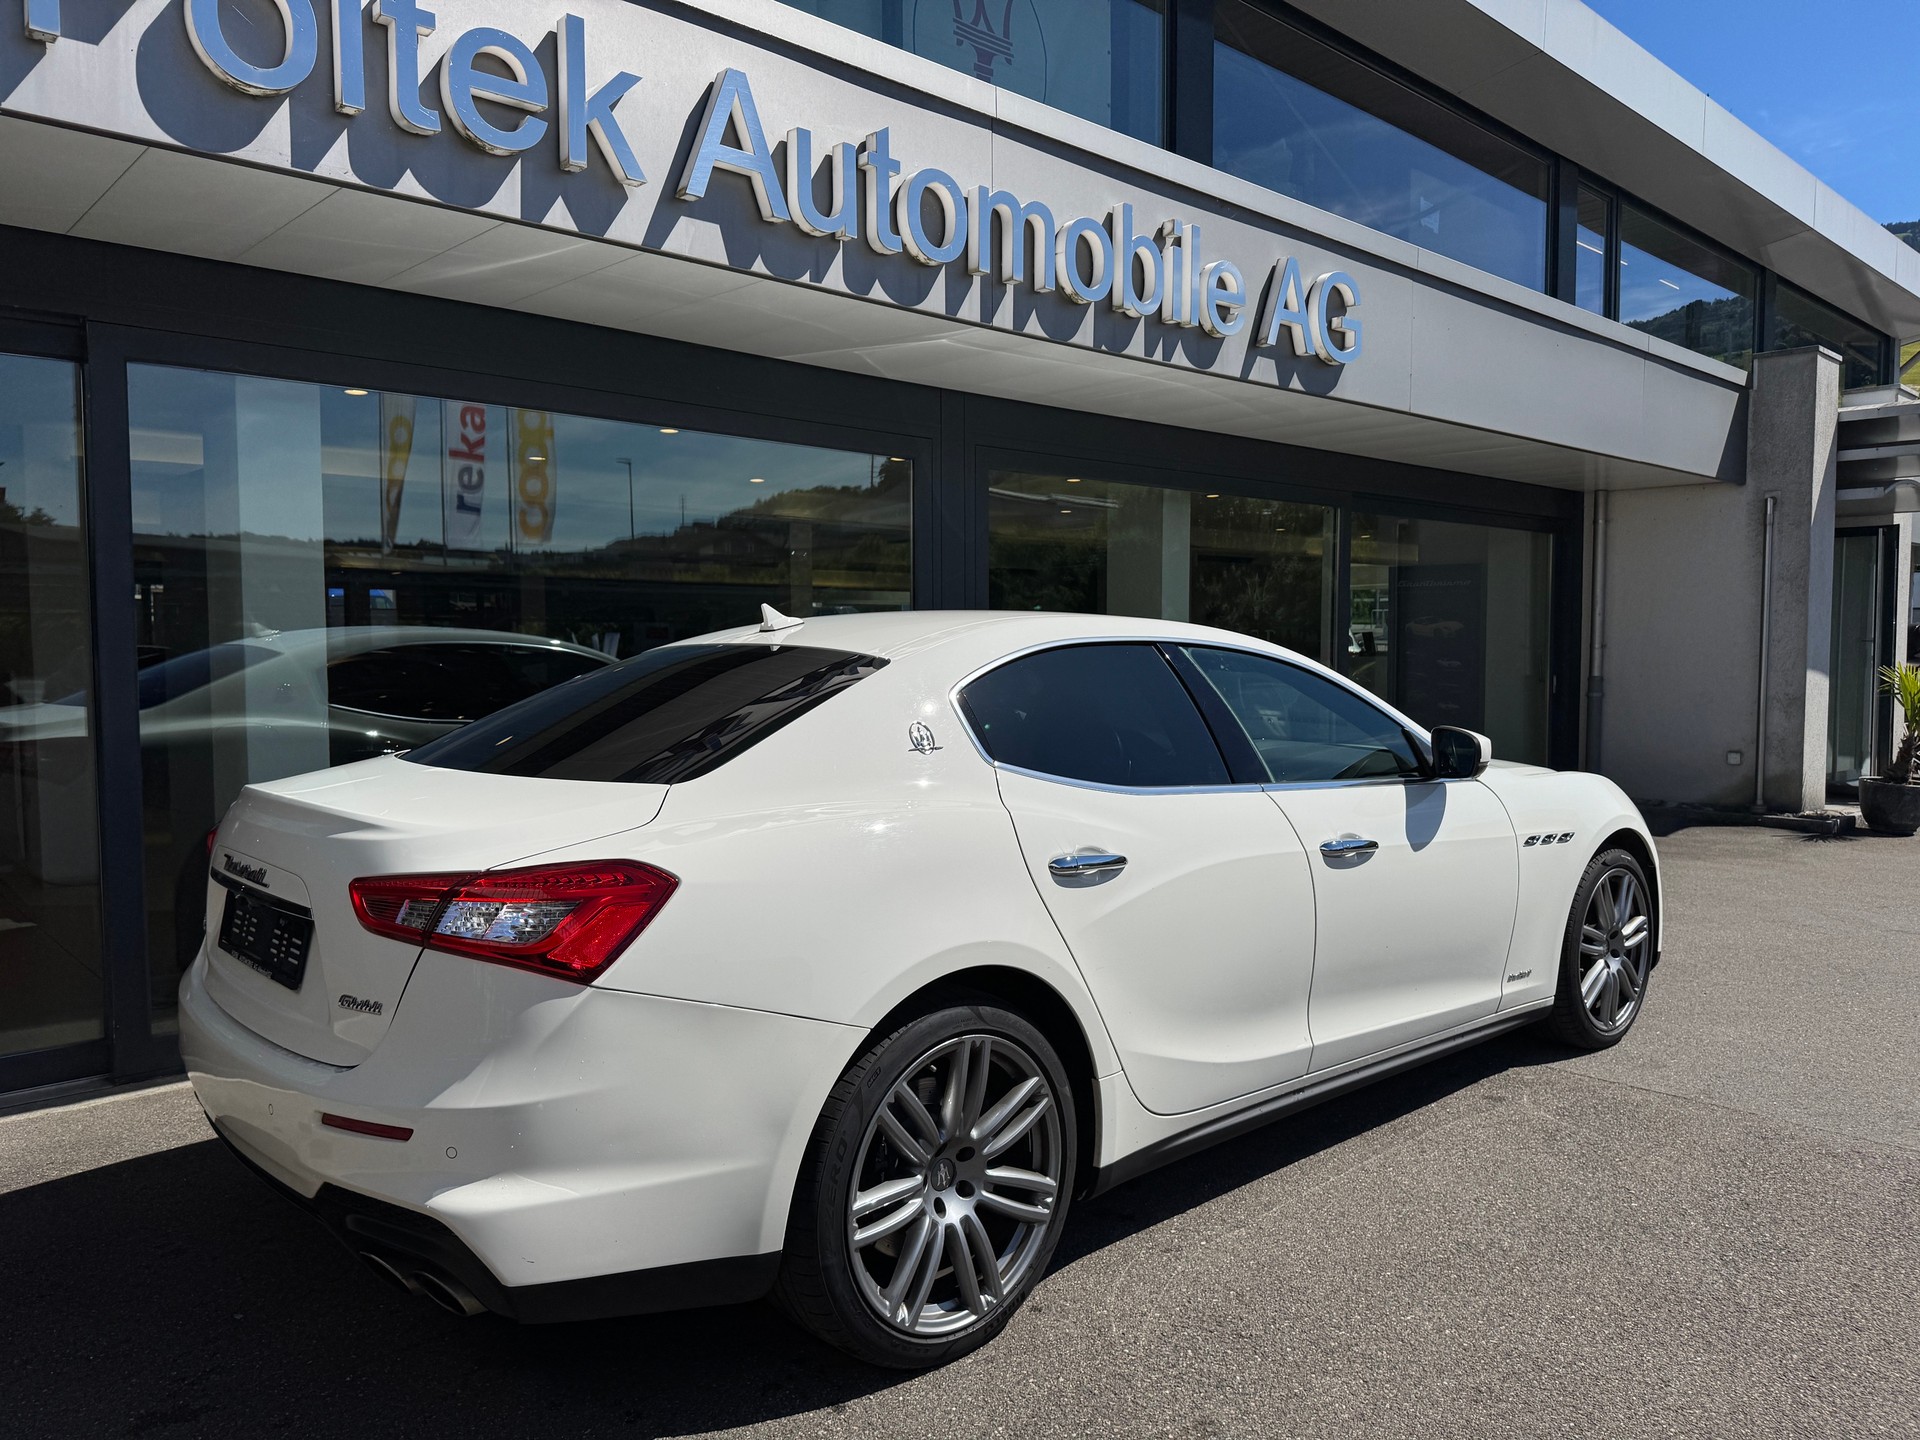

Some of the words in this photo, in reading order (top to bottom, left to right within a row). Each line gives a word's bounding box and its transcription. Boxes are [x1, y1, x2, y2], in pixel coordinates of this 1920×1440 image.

[24, 0, 648, 188] oltek
[676, 67, 1247, 339] Automobile
[1256, 255, 1363, 367] AG
[448, 404, 487, 517] reka
